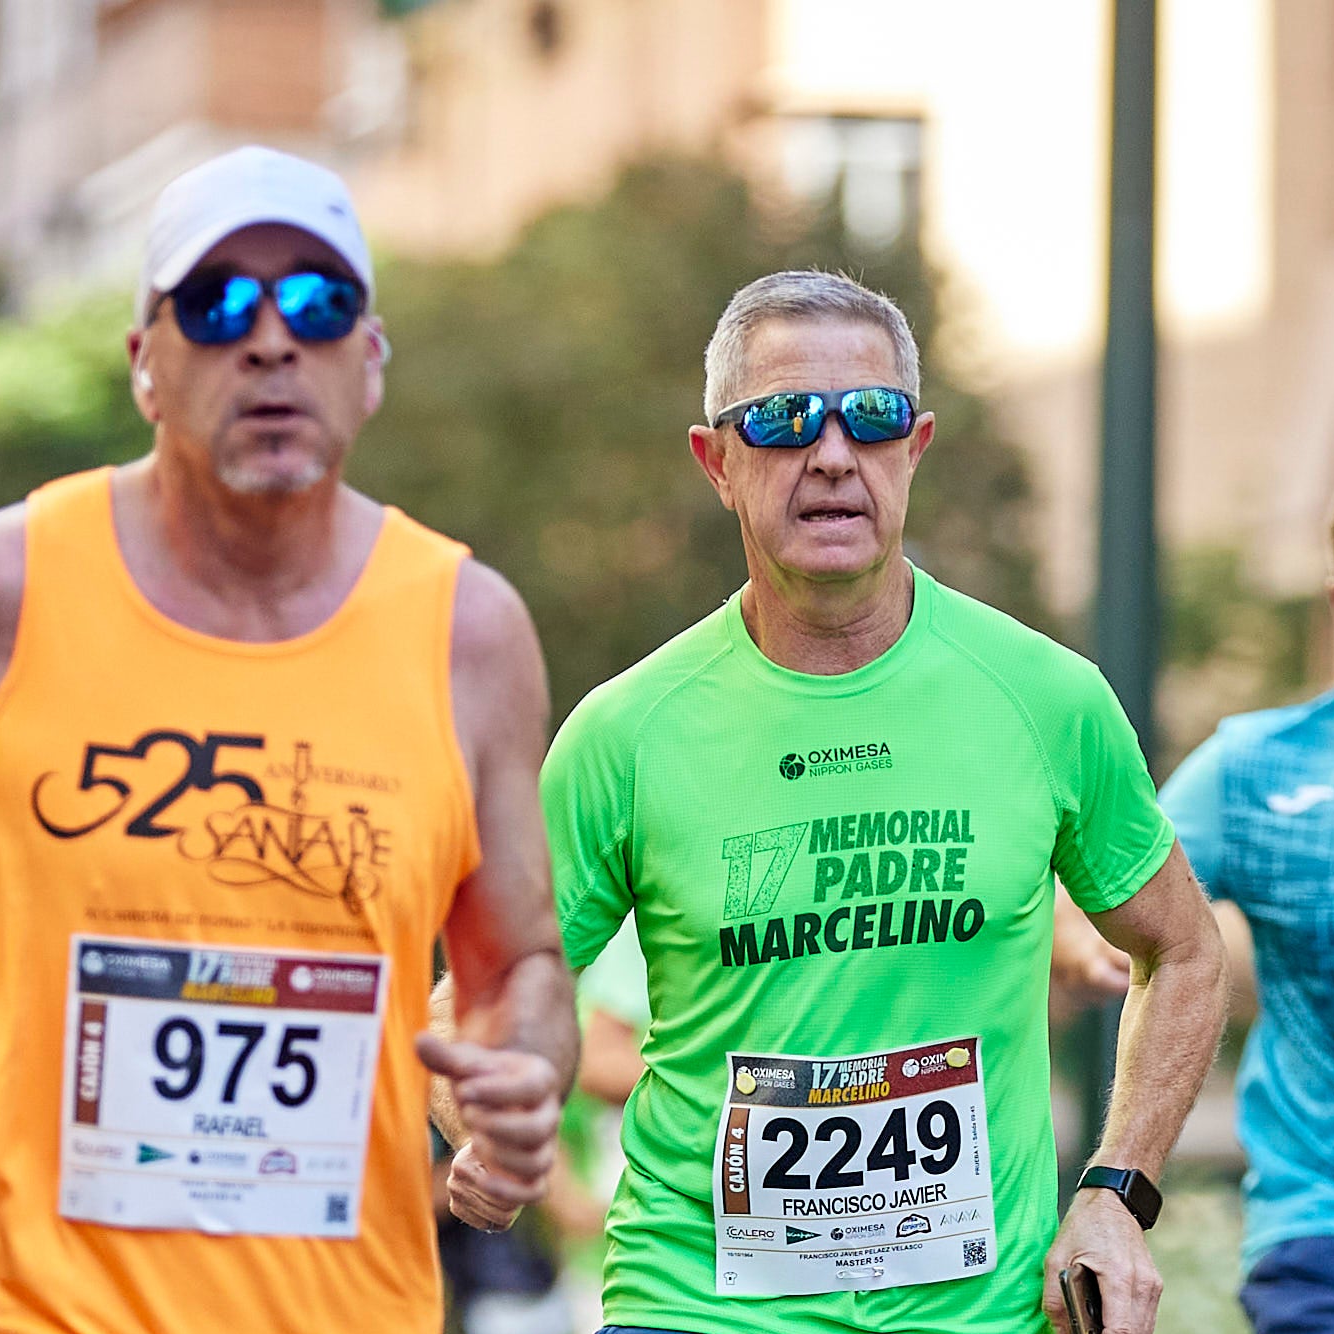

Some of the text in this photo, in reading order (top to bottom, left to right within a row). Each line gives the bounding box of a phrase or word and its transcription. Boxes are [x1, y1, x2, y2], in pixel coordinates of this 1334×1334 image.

[808, 742, 891, 765] OXIMESA
[809, 758, 893, 778] NIPPON GASES
[31, 728, 265, 839] 525
[808, 809, 975, 854] MEMORIAL
[722, 822, 809, 921] 17
[813, 848, 968, 903] PADRE
[719, 898, 986, 967] MARCELINO
[104, 953, 172, 972] OXIMESA
[313, 968, 375, 984] OXIMESA
[151, 1015, 322, 1109] 975
[920, 1048, 971, 1067] OXIM
[752, 1067, 795, 1080] OXIMESA
[811, 1056, 888, 1089] 17 MEMORIAL
[839, 1067, 884, 1088] PADRE
[774, 1080, 795, 1089] GASES
[807, 1081, 890, 1103] MARCELINO
[192, 1113, 269, 1139] RAFAEL
[761, 1100, 962, 1190] 2249
[725, 1127, 745, 1193] CAJÓN 4
[783, 1183, 947, 1216] FRANCISCO JAVIER
[845, 1223, 885, 1234] OXIMESA
[940, 1209, 981, 1226] ANAYA
[729, 1228, 775, 1238] CALERO
[799, 1252, 838, 1260] FRANCISCO
[839, 1250, 863, 1258] JAVIER
[890, 1244, 923, 1253] VELASCO
[835, 1256, 884, 1267] MASTER 55
